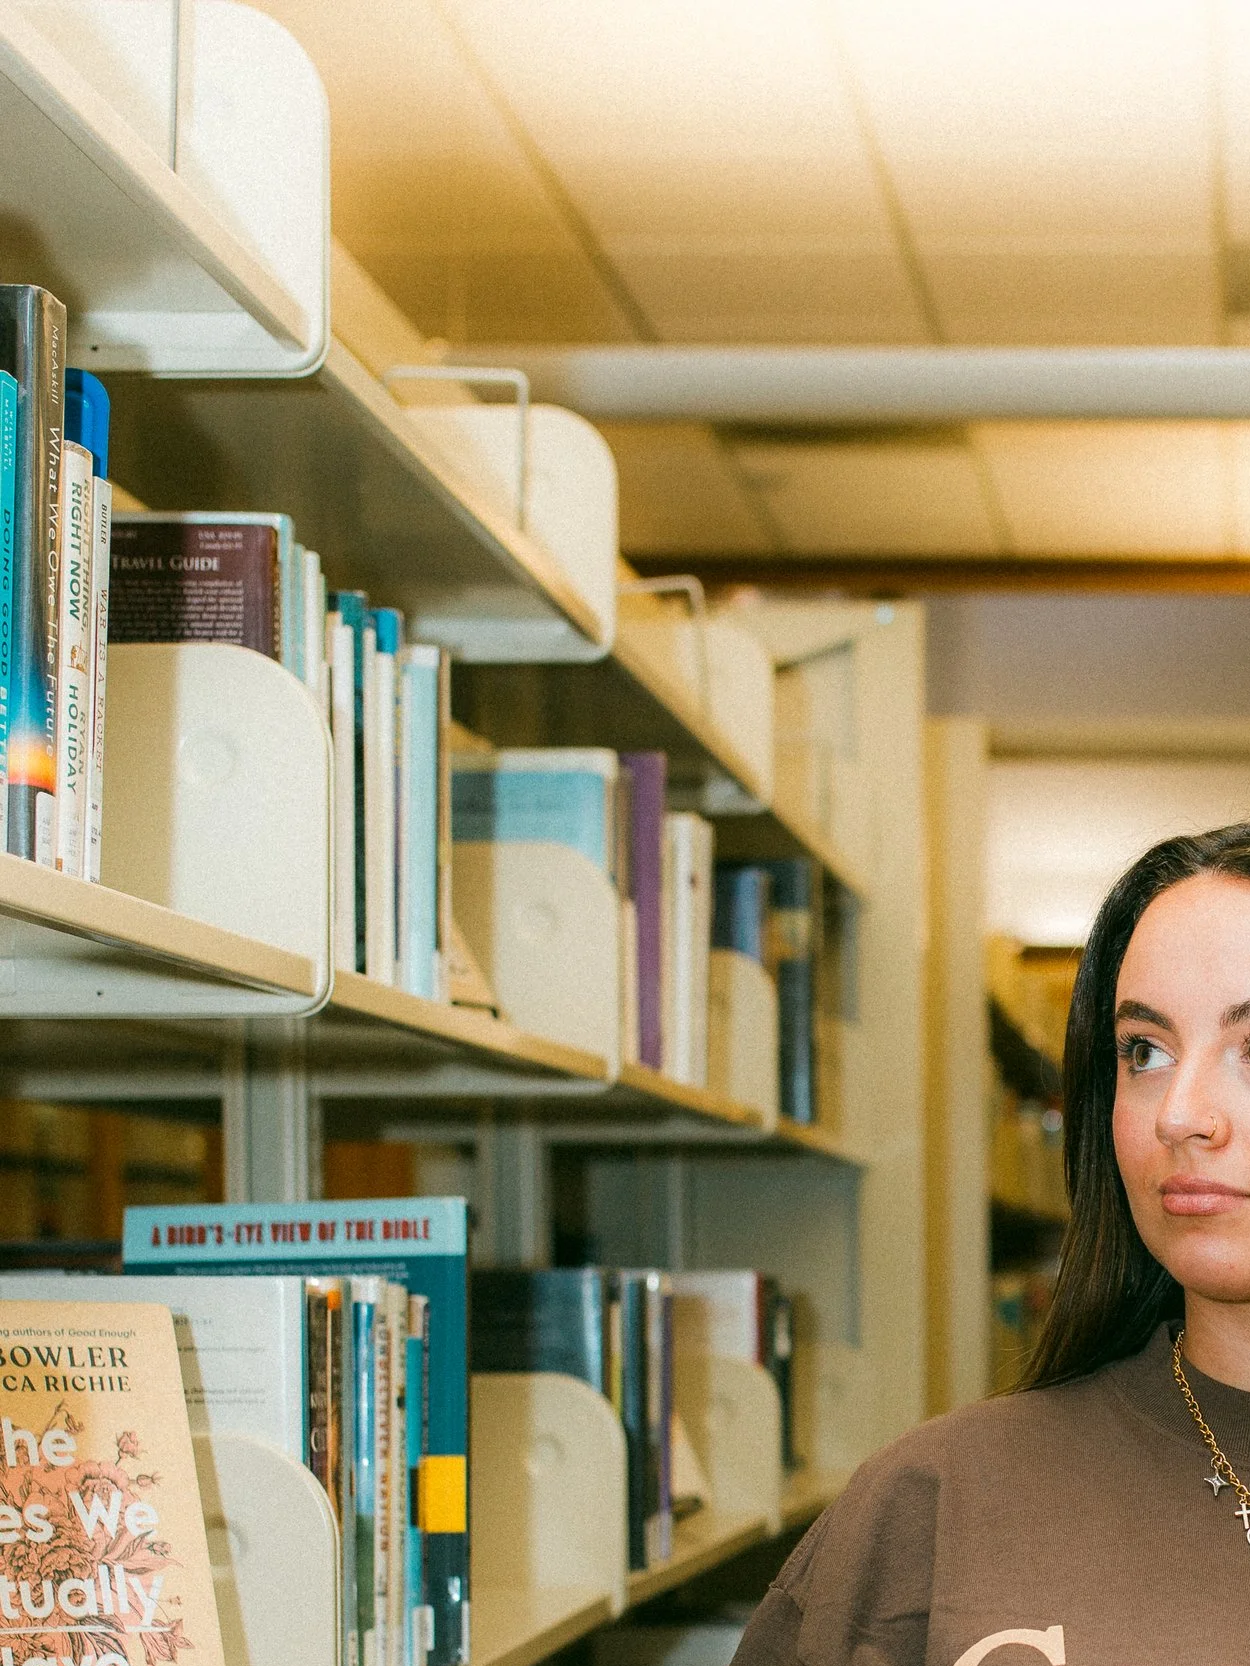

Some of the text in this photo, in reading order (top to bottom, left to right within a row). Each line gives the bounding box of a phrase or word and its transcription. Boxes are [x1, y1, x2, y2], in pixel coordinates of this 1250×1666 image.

[51, 325, 59, 405] MacAskill
[100, 503, 108, 544] BUTLER
[69, 482, 82, 621] RIGHT NOW
[169, 556, 221, 572] GUIDE
[2, 509, 11, 676] DOING GOOD
[46, 427, 60, 758] What We Owe The Future
[99, 589, 108, 629] WAR
[66, 684, 79, 795] HOLIDAY
[77, 711, 87, 775] RYAN
[151, 1225, 162, 1246] A
[270, 1221, 312, 1243] VIEW
[316, 1221, 337, 1243] OF
[345, 1219, 376, 1241] THE
[381, 1217, 431, 1241] BIBLE
[12, 1327, 137, 1340] authors of Good Enough
[44, 1374, 132, 1393] RICHIE
[69, 1489, 161, 1541] We
